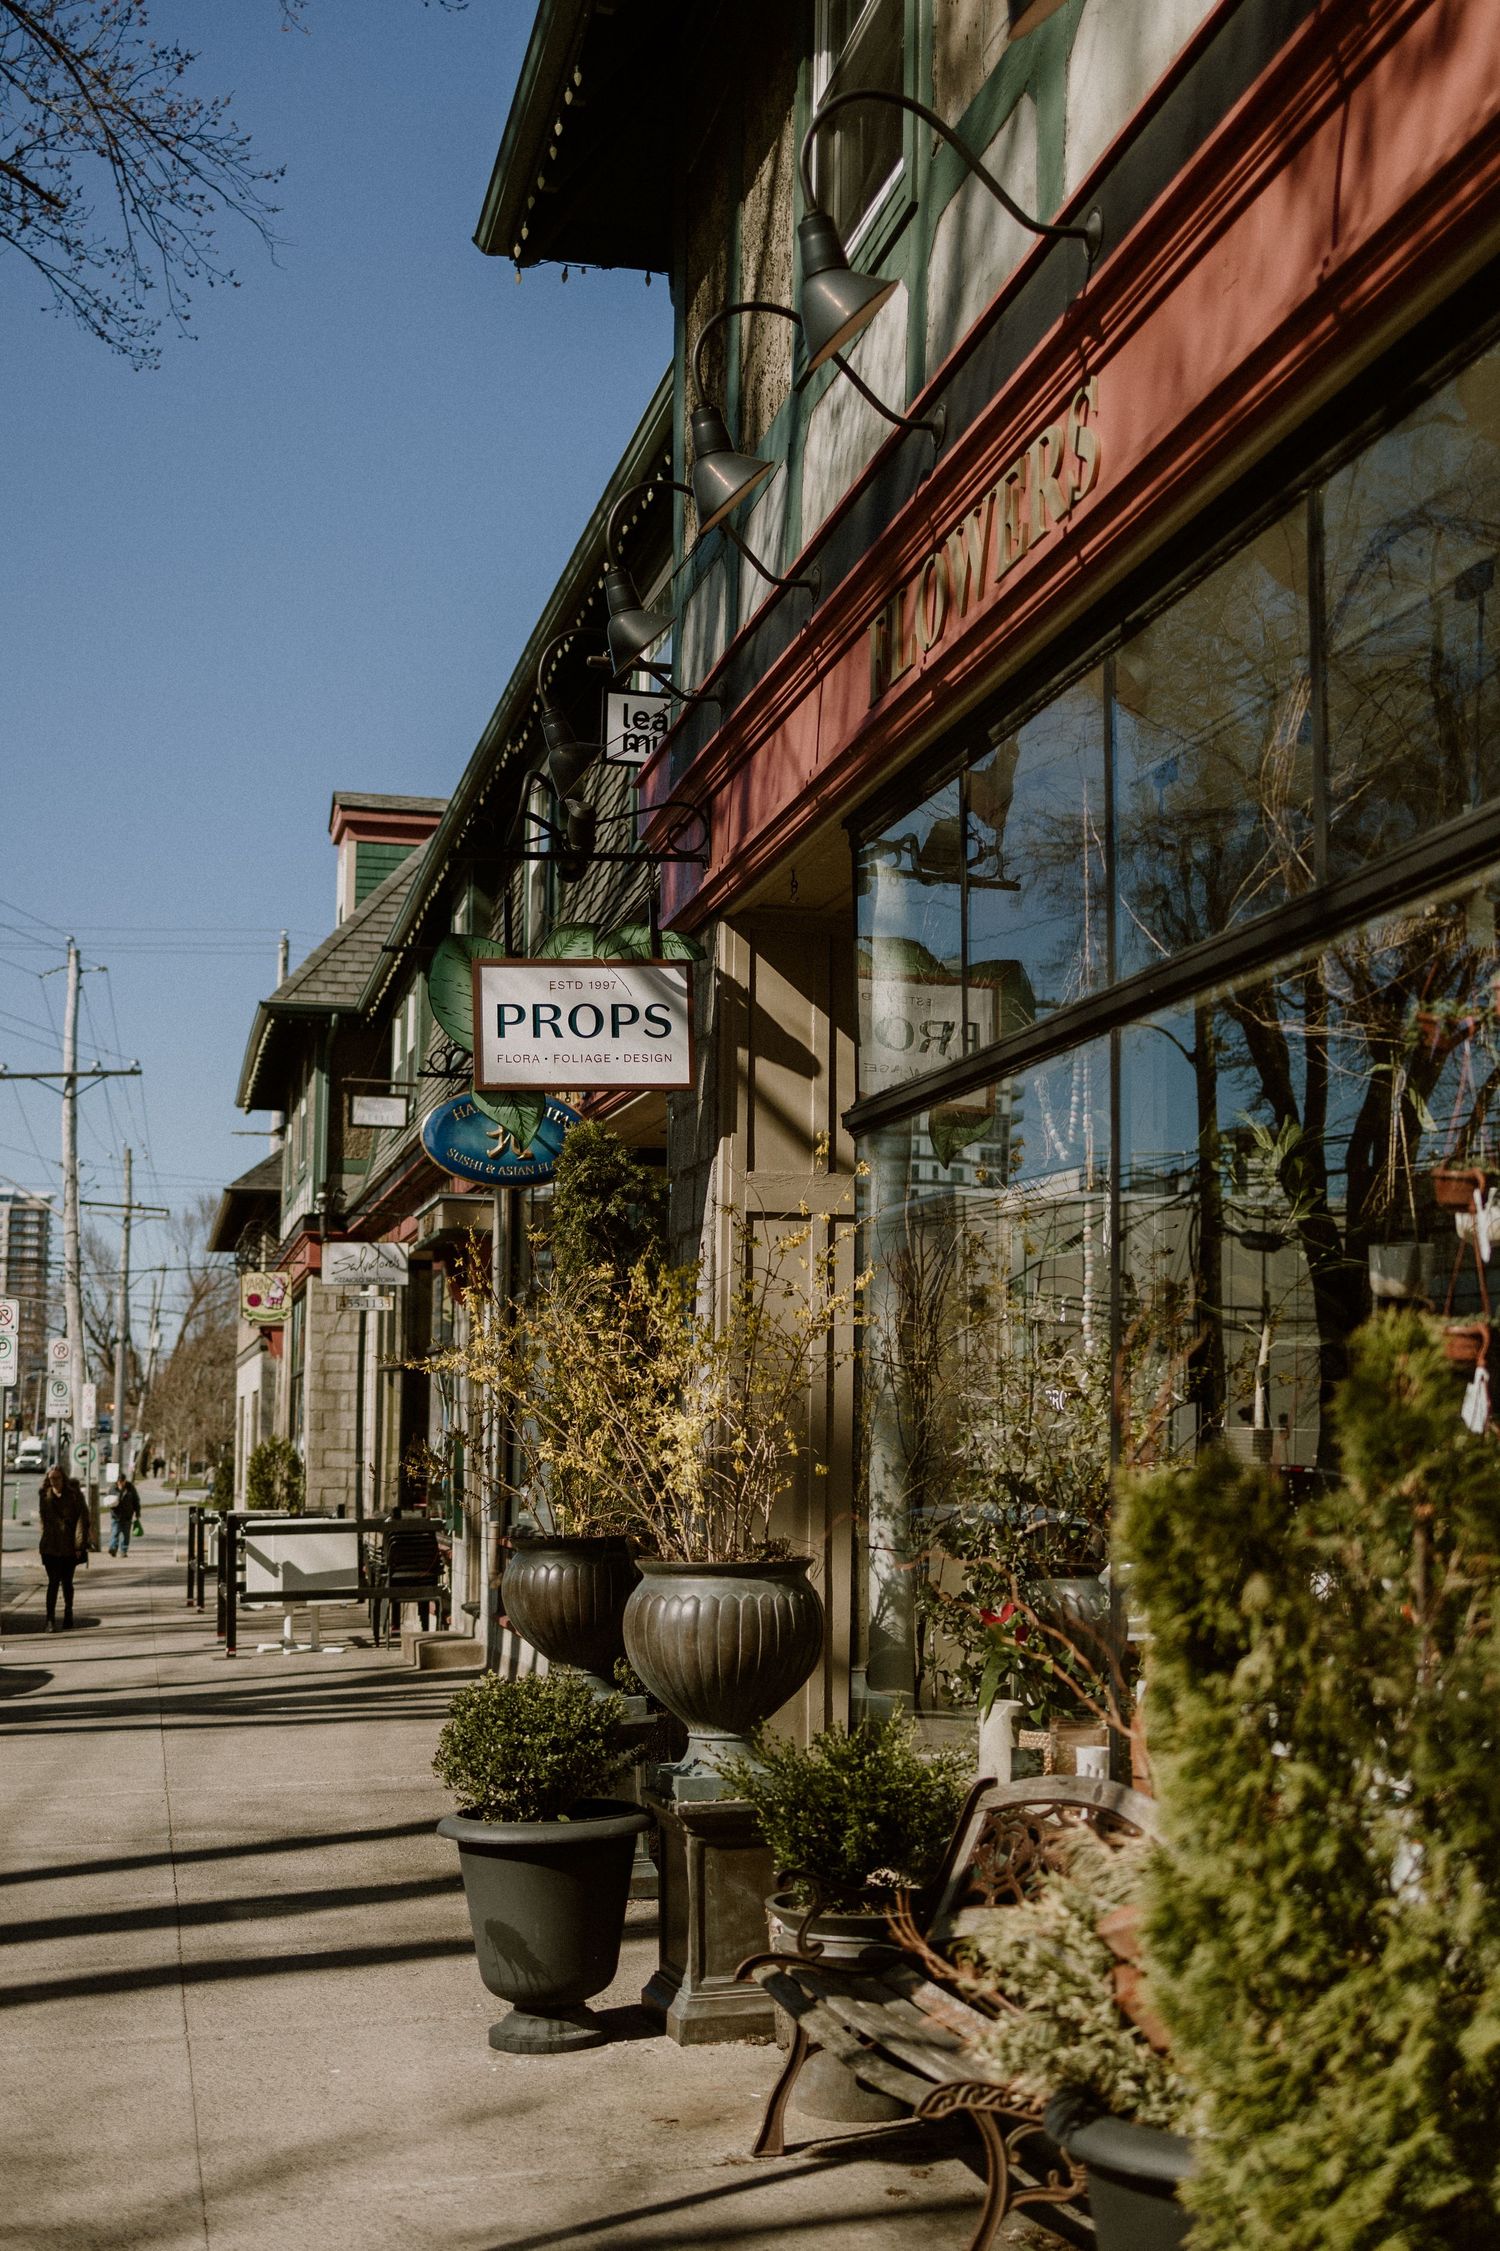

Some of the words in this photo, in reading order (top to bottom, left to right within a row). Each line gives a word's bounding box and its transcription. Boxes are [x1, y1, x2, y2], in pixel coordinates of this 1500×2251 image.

[867, 375, 1101, 709] FLOWERS
[549, 980, 584, 990] ESTD
[589, 981, 617, 990] 1997
[497, 1003, 673, 1039] PROPS
[497, 1054, 540, 1064] FLORA
[553, 1054, 611, 1063] FOLIAGE
[623, 1053, 673, 1063] DESIGN
[447, 1148, 483, 1171] SUSHI
[486, 1166, 496, 1174] &
[498, 1166, 535, 1176] ASIAN
